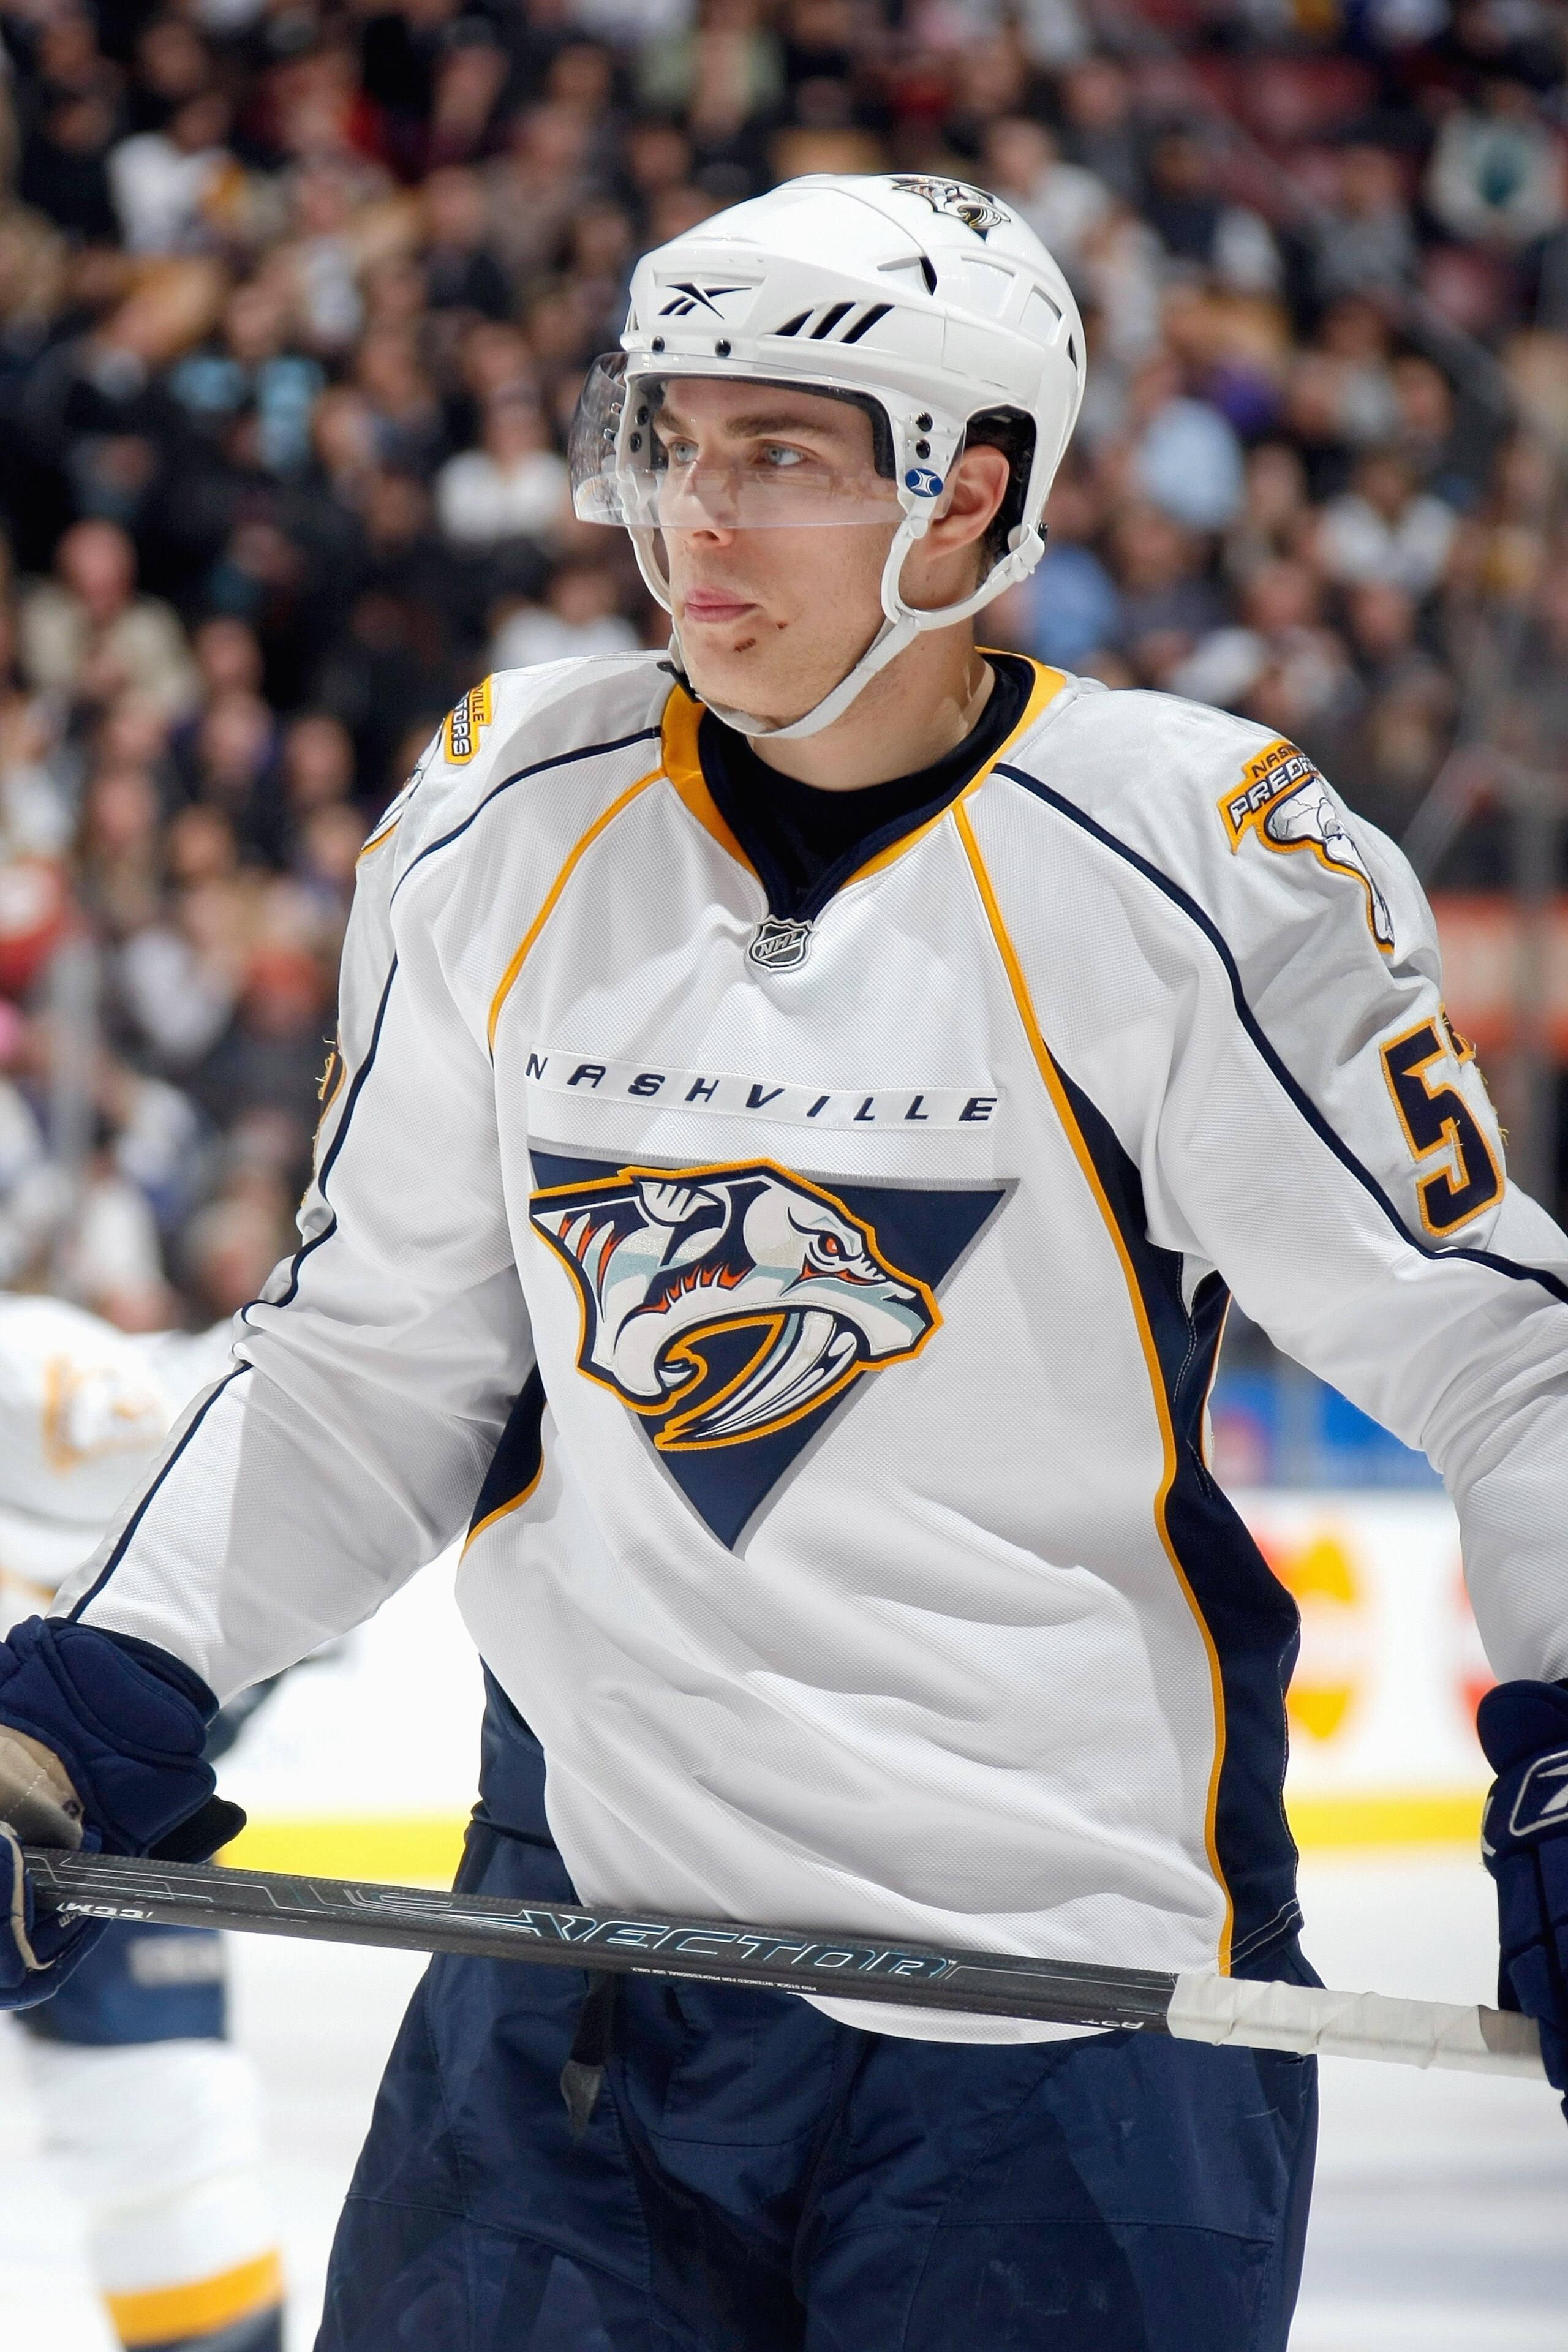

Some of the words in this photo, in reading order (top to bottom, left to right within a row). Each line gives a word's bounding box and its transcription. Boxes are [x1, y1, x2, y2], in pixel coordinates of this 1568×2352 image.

[472, 685, 484, 722] VILLE
[758, 932, 800, 957] NHL
[525, 1053, 997, 1121] NASHVILLE
[1379, 1005, 1505, 1238] 5
[66, 1902, 145, 1920] CCM
[521, 1908, 947, 1980] VECTOR
[667, 1970, 721, 1981] PROFESSIONAL
